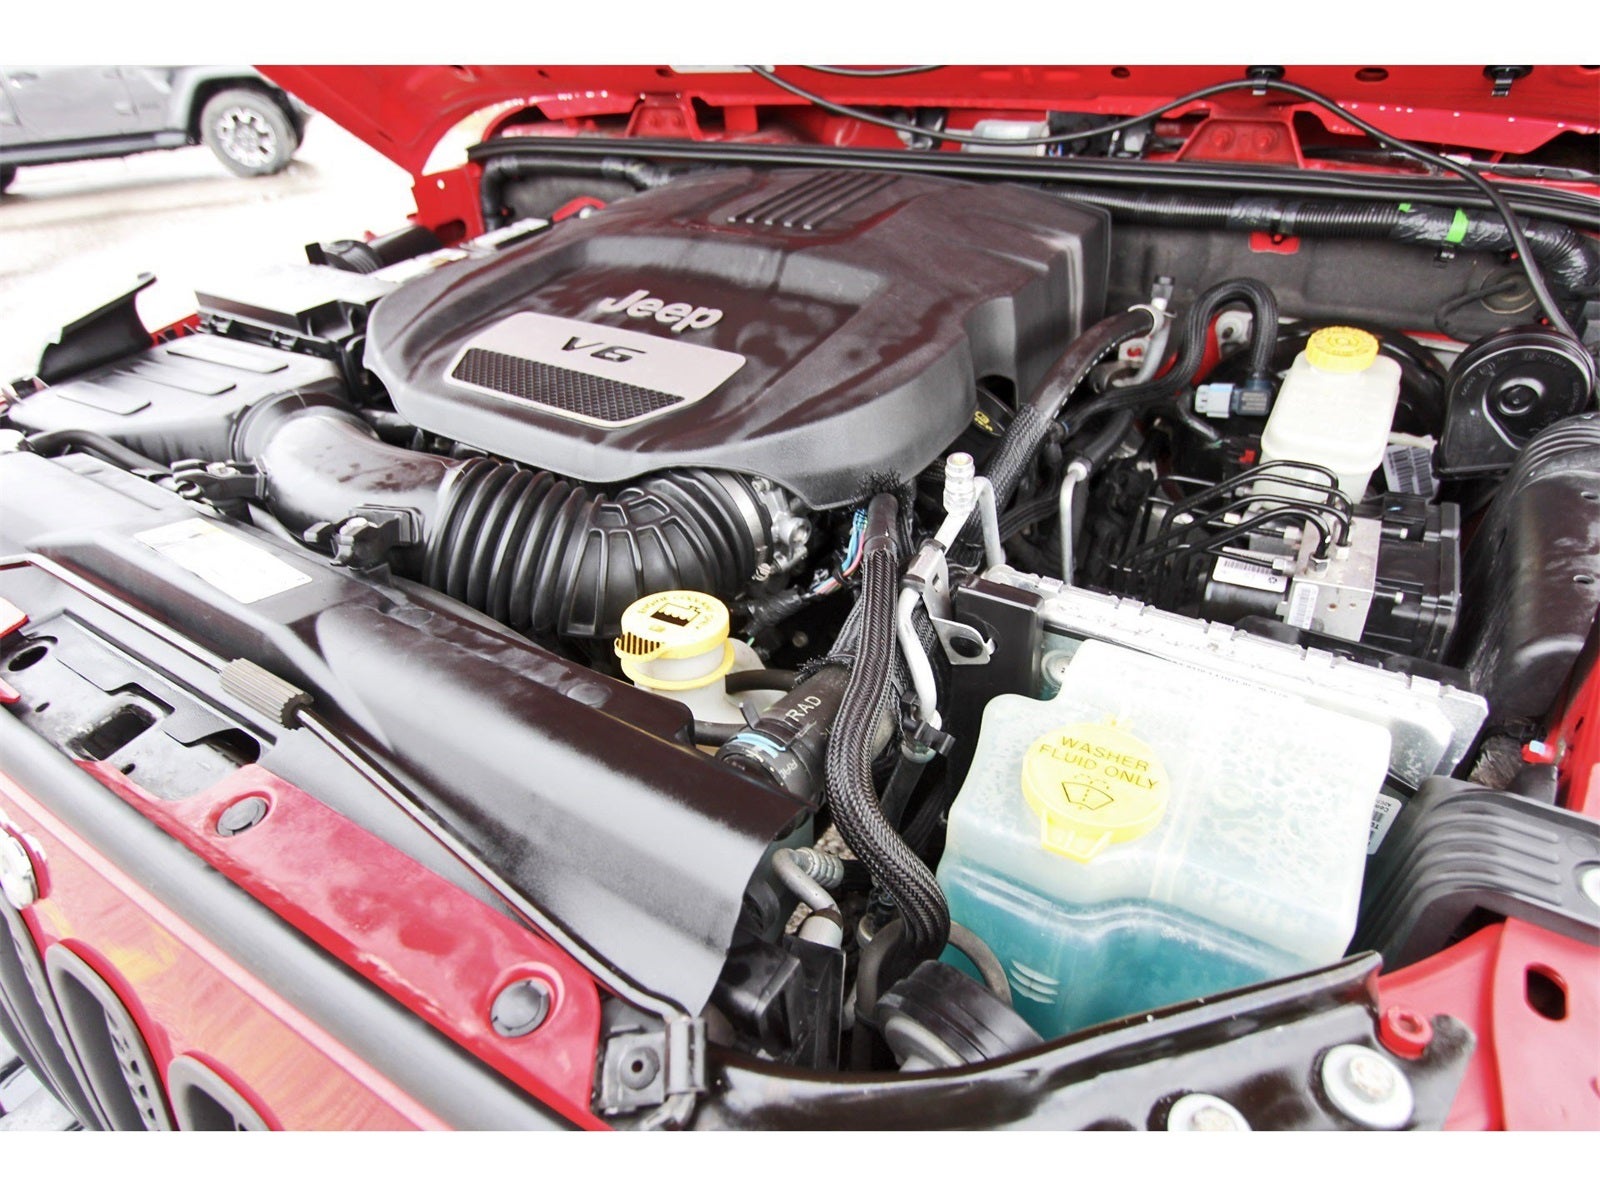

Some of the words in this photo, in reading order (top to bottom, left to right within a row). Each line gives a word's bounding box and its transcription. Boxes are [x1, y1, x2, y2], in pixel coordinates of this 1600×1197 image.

[597, 288, 724, 334] Jeep
[561, 335, 646, 363] V6
[785, 695, 822, 722] RAD
[1039, 743, 1098, 771] FLUID
[1104, 764, 1160, 790] ONLY
[1061, 735, 1150, 772] WASHER
